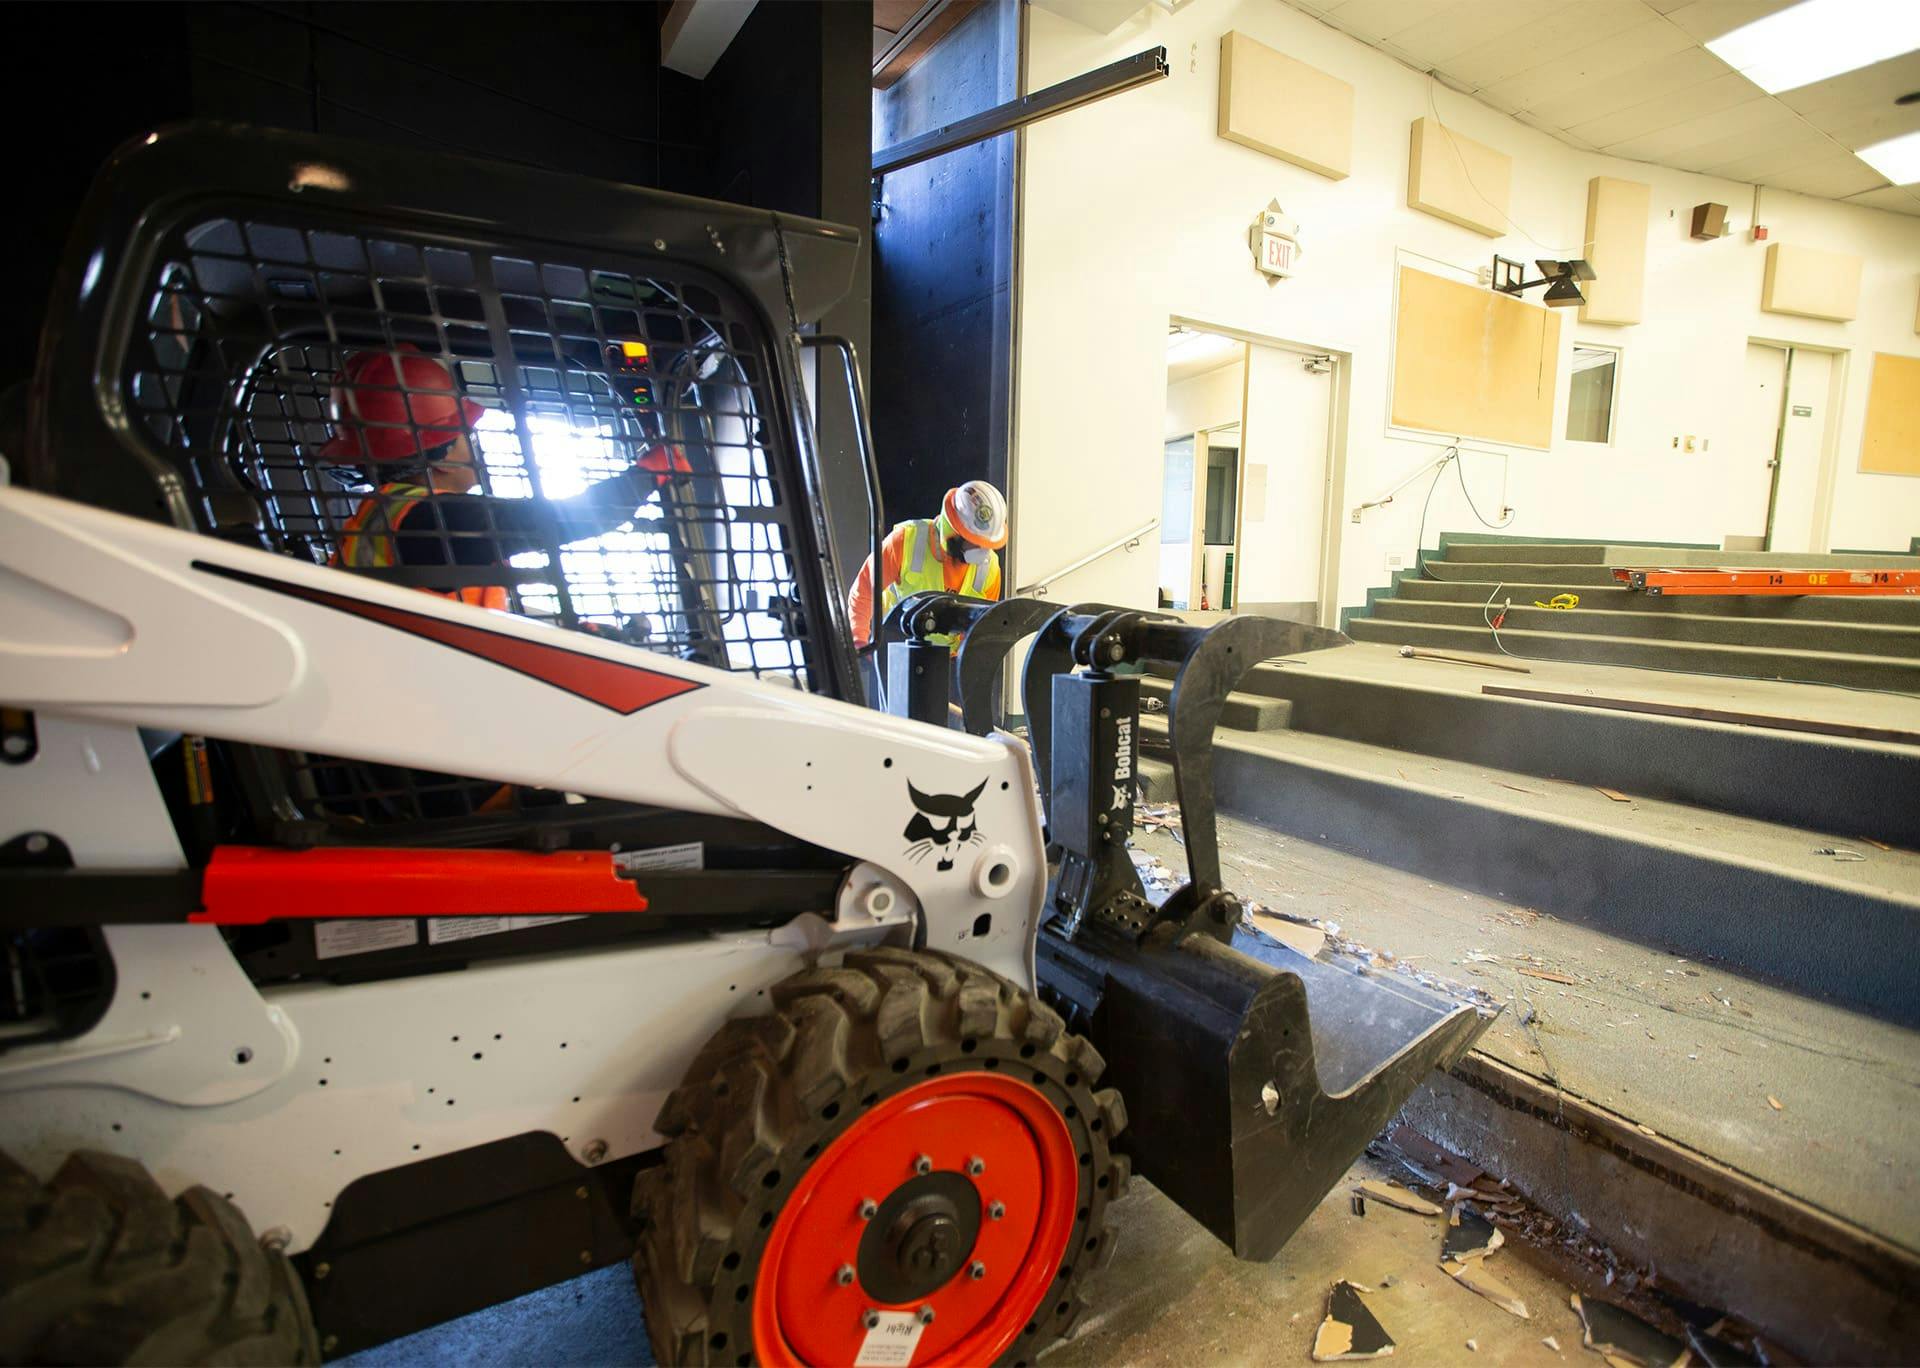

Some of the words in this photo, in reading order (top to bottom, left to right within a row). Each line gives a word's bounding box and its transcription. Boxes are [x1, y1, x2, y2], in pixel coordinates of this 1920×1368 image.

[1269, 240, 1292, 269] EXIT
[1769, 575, 1783, 585] 14
[1873, 573, 1889, 584] 14
[1115, 717, 1131, 780] Bobcat
[886, 1322, 913, 1336] Right
